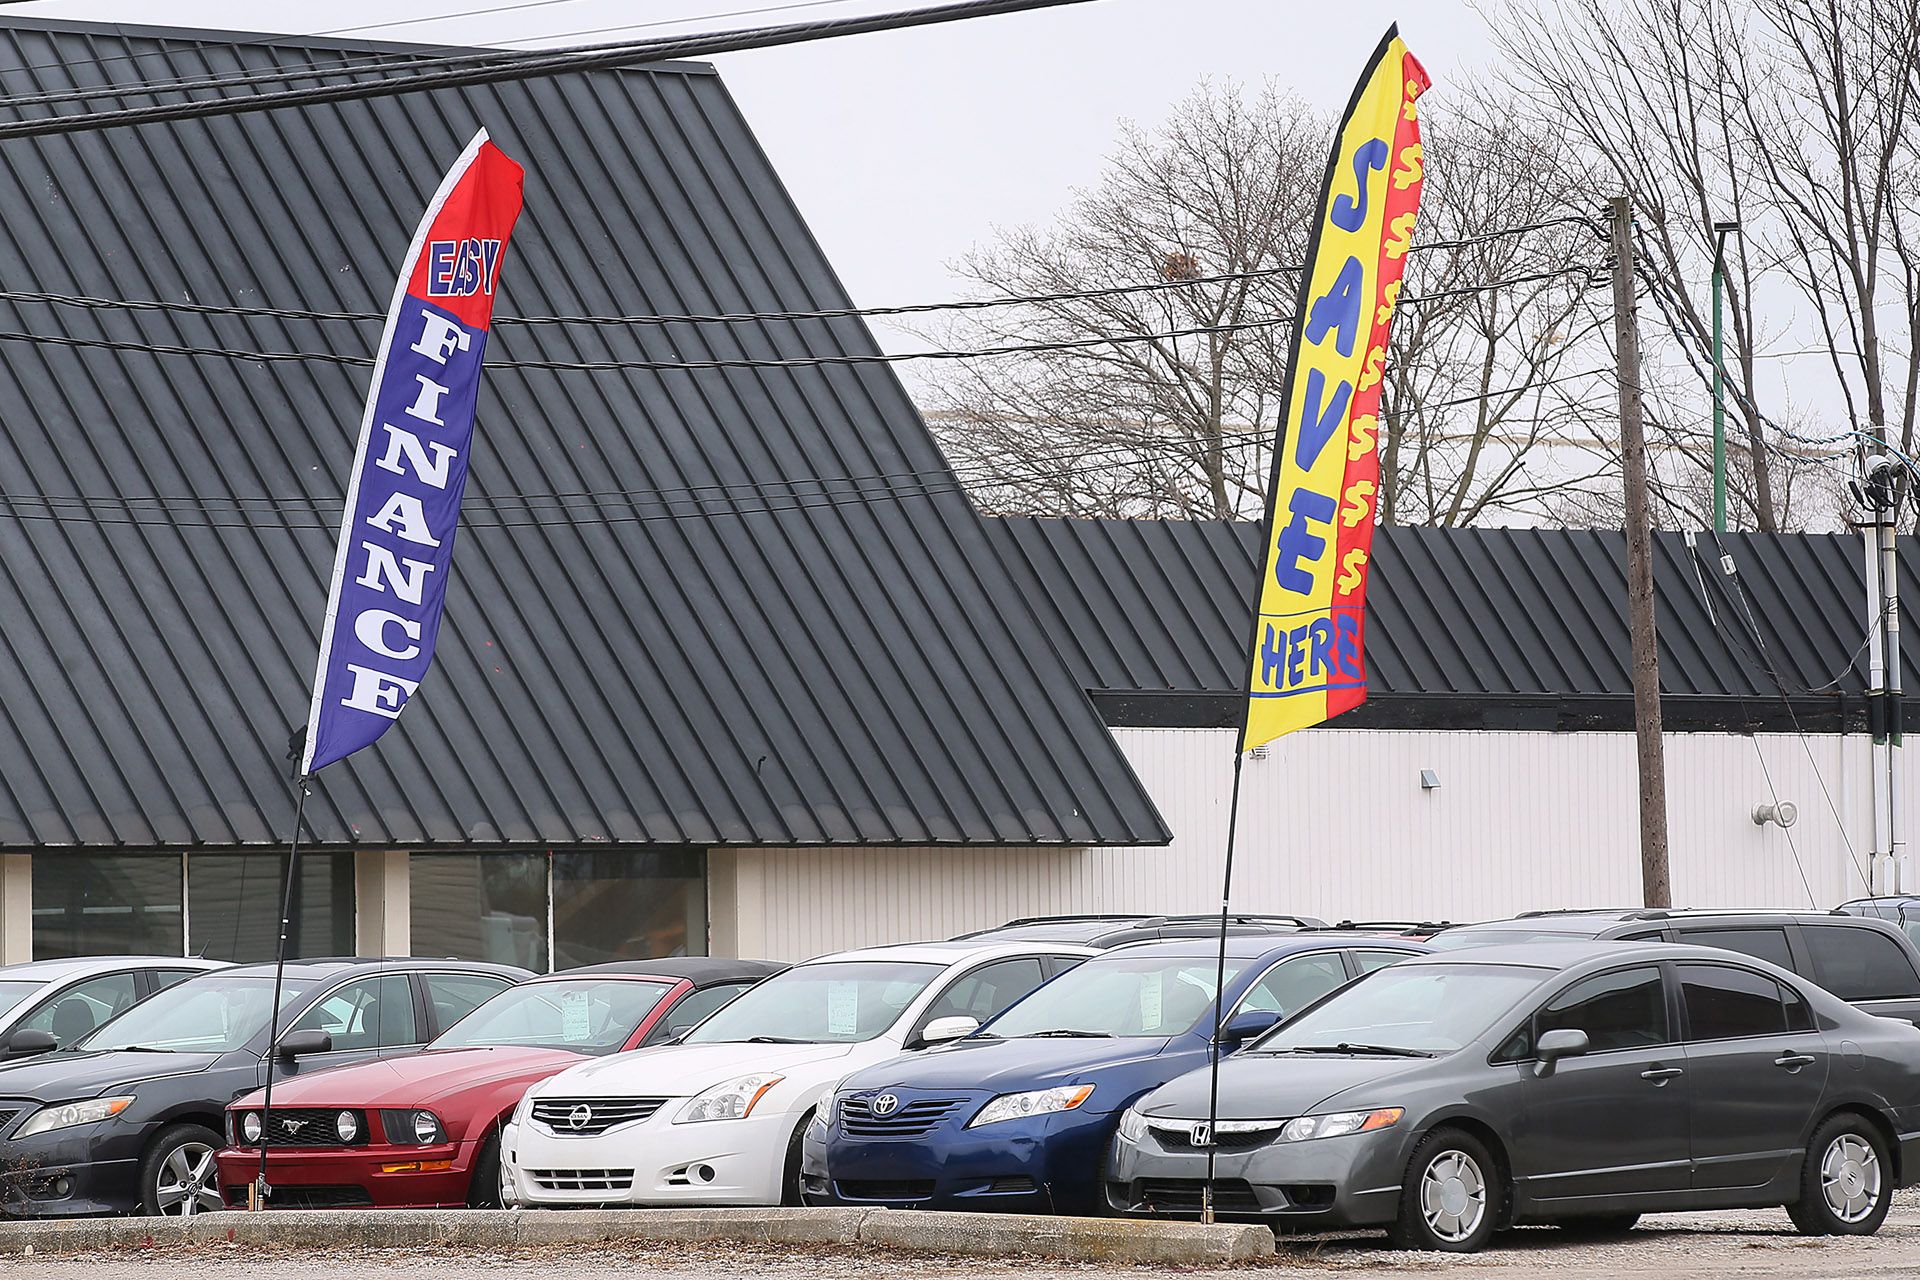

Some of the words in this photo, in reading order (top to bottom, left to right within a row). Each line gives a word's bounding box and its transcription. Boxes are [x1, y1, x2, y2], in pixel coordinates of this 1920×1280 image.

[427, 237, 502, 298] EASY
[1275, 137, 1389, 595] SAVE
[341, 309, 471, 720] FINANCE
[1261, 614, 1358, 690] HERE
